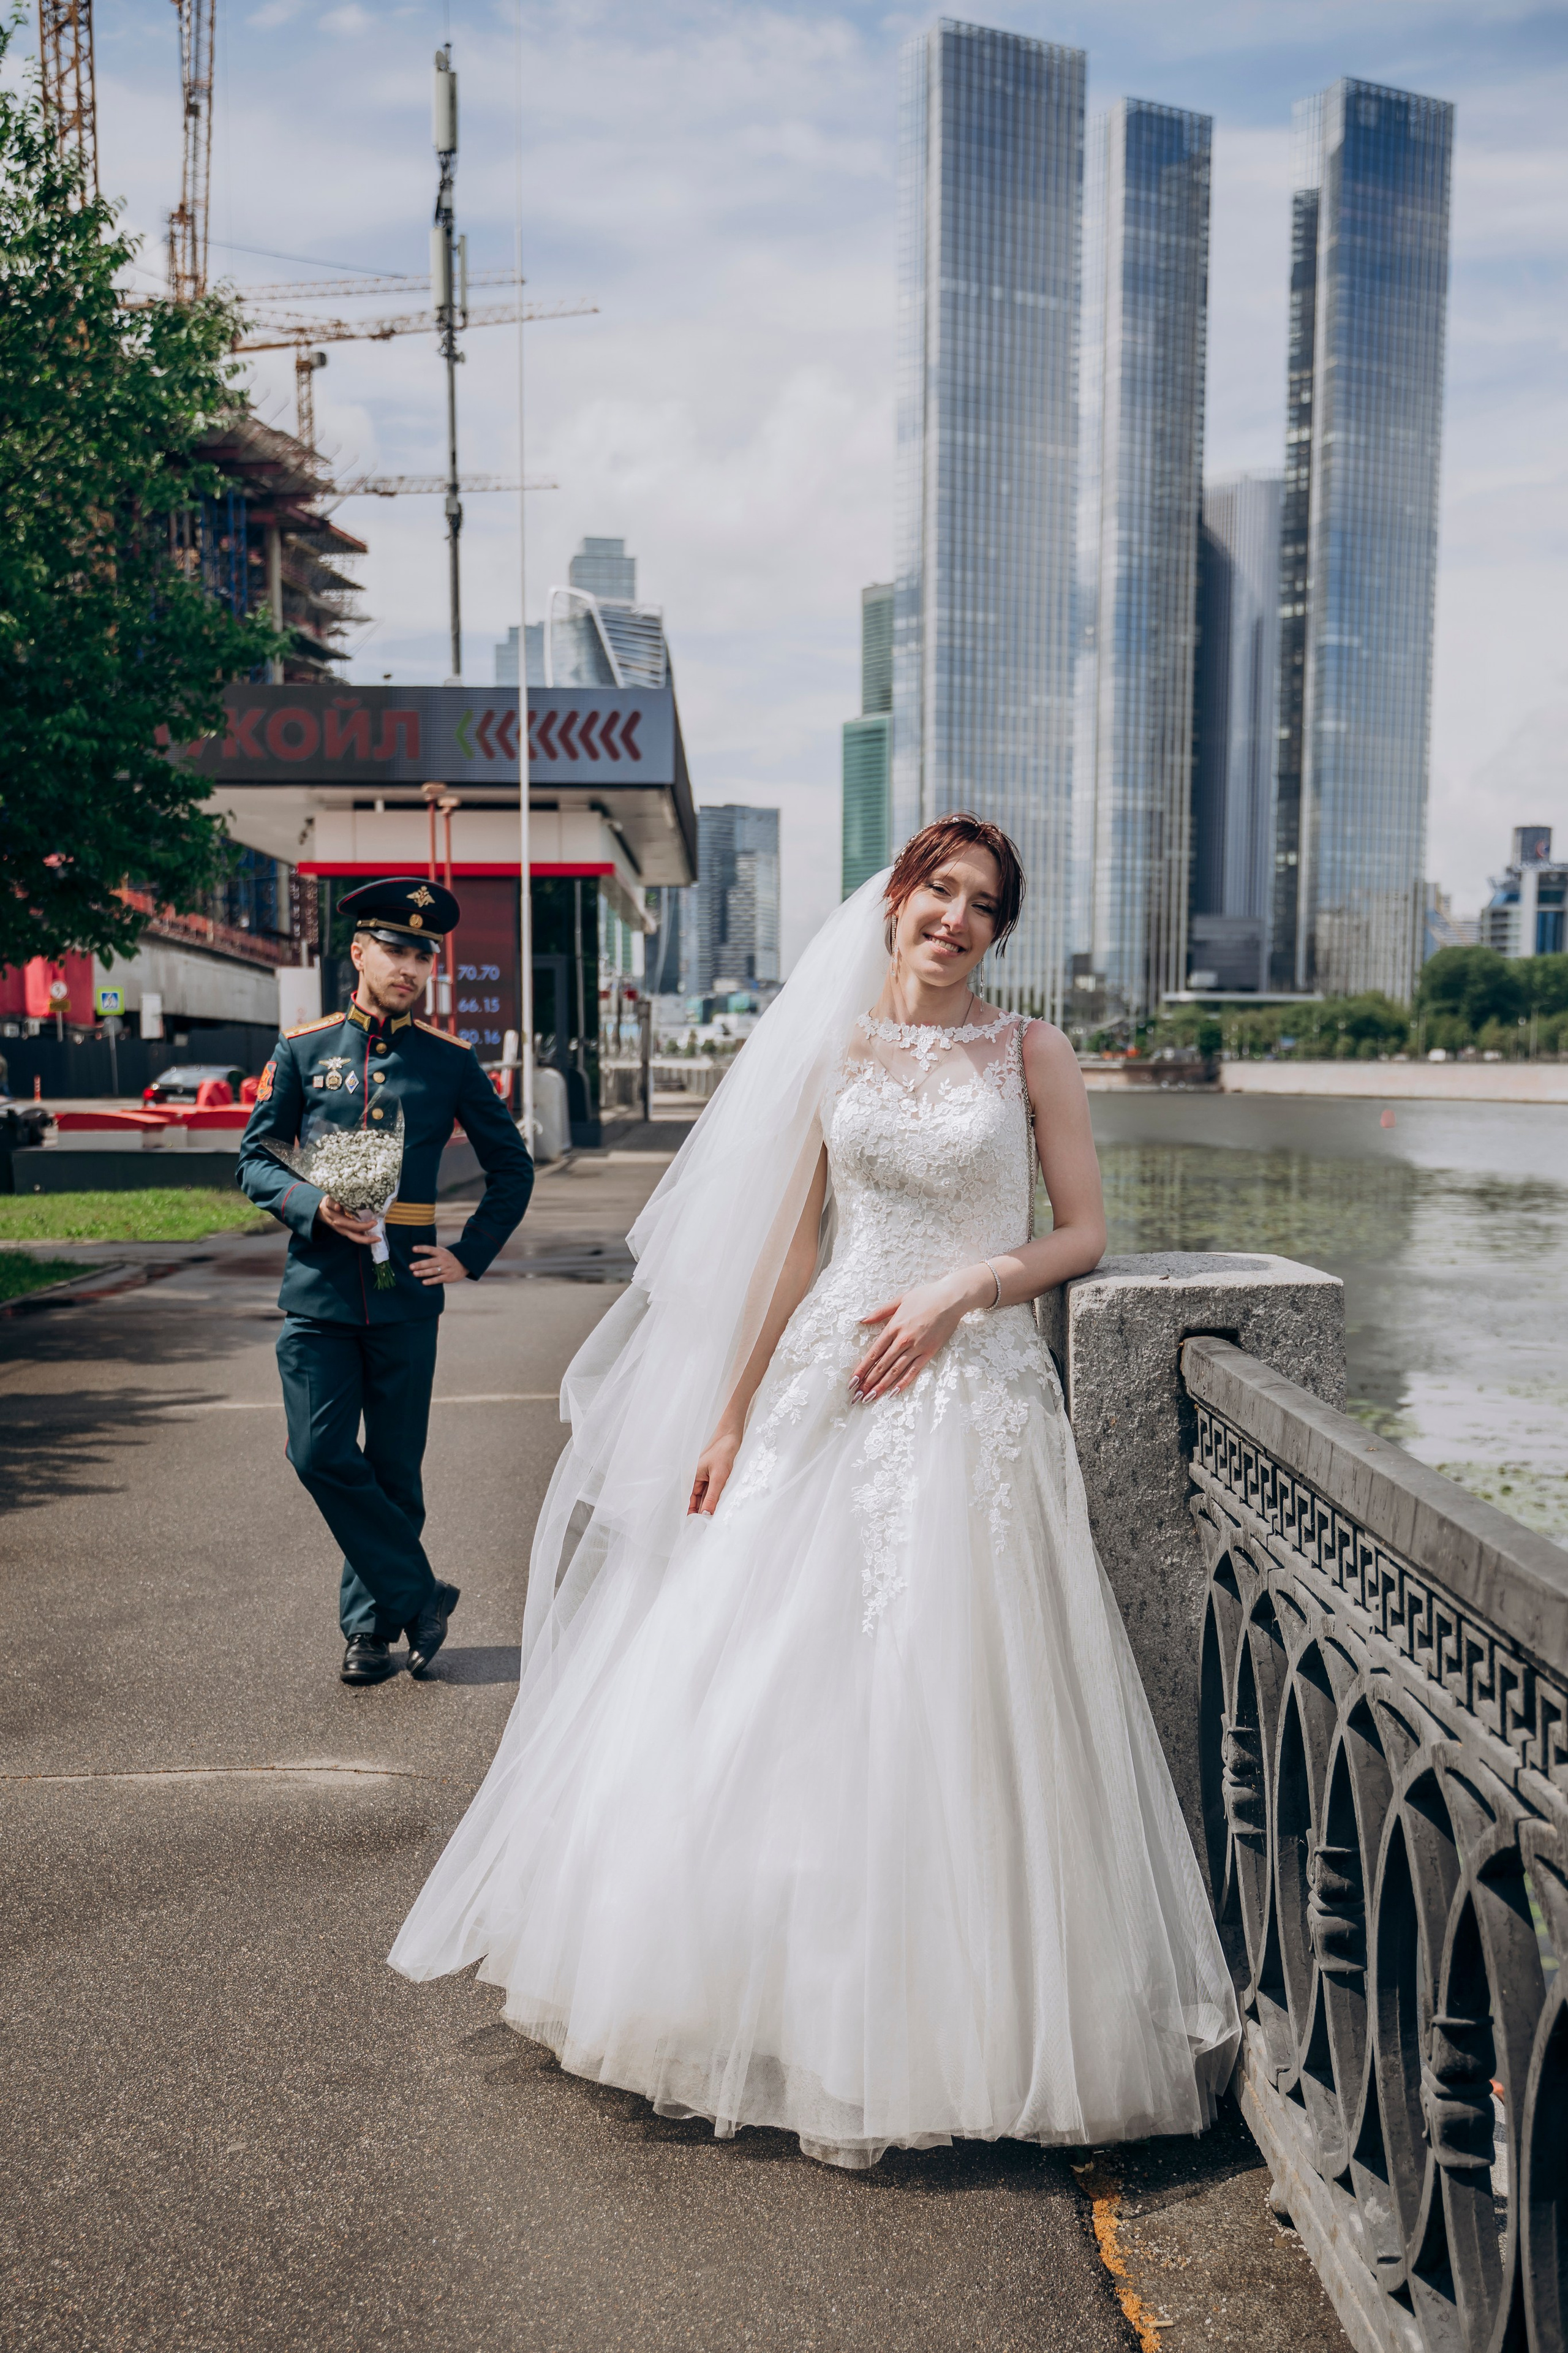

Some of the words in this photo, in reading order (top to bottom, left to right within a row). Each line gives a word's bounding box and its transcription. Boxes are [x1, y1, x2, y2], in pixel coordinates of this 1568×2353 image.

[154, 698, 421, 760] КОЙЛ
[458, 965, 500, 981] 70.70
[458, 997, 500, 1013] 66.15
